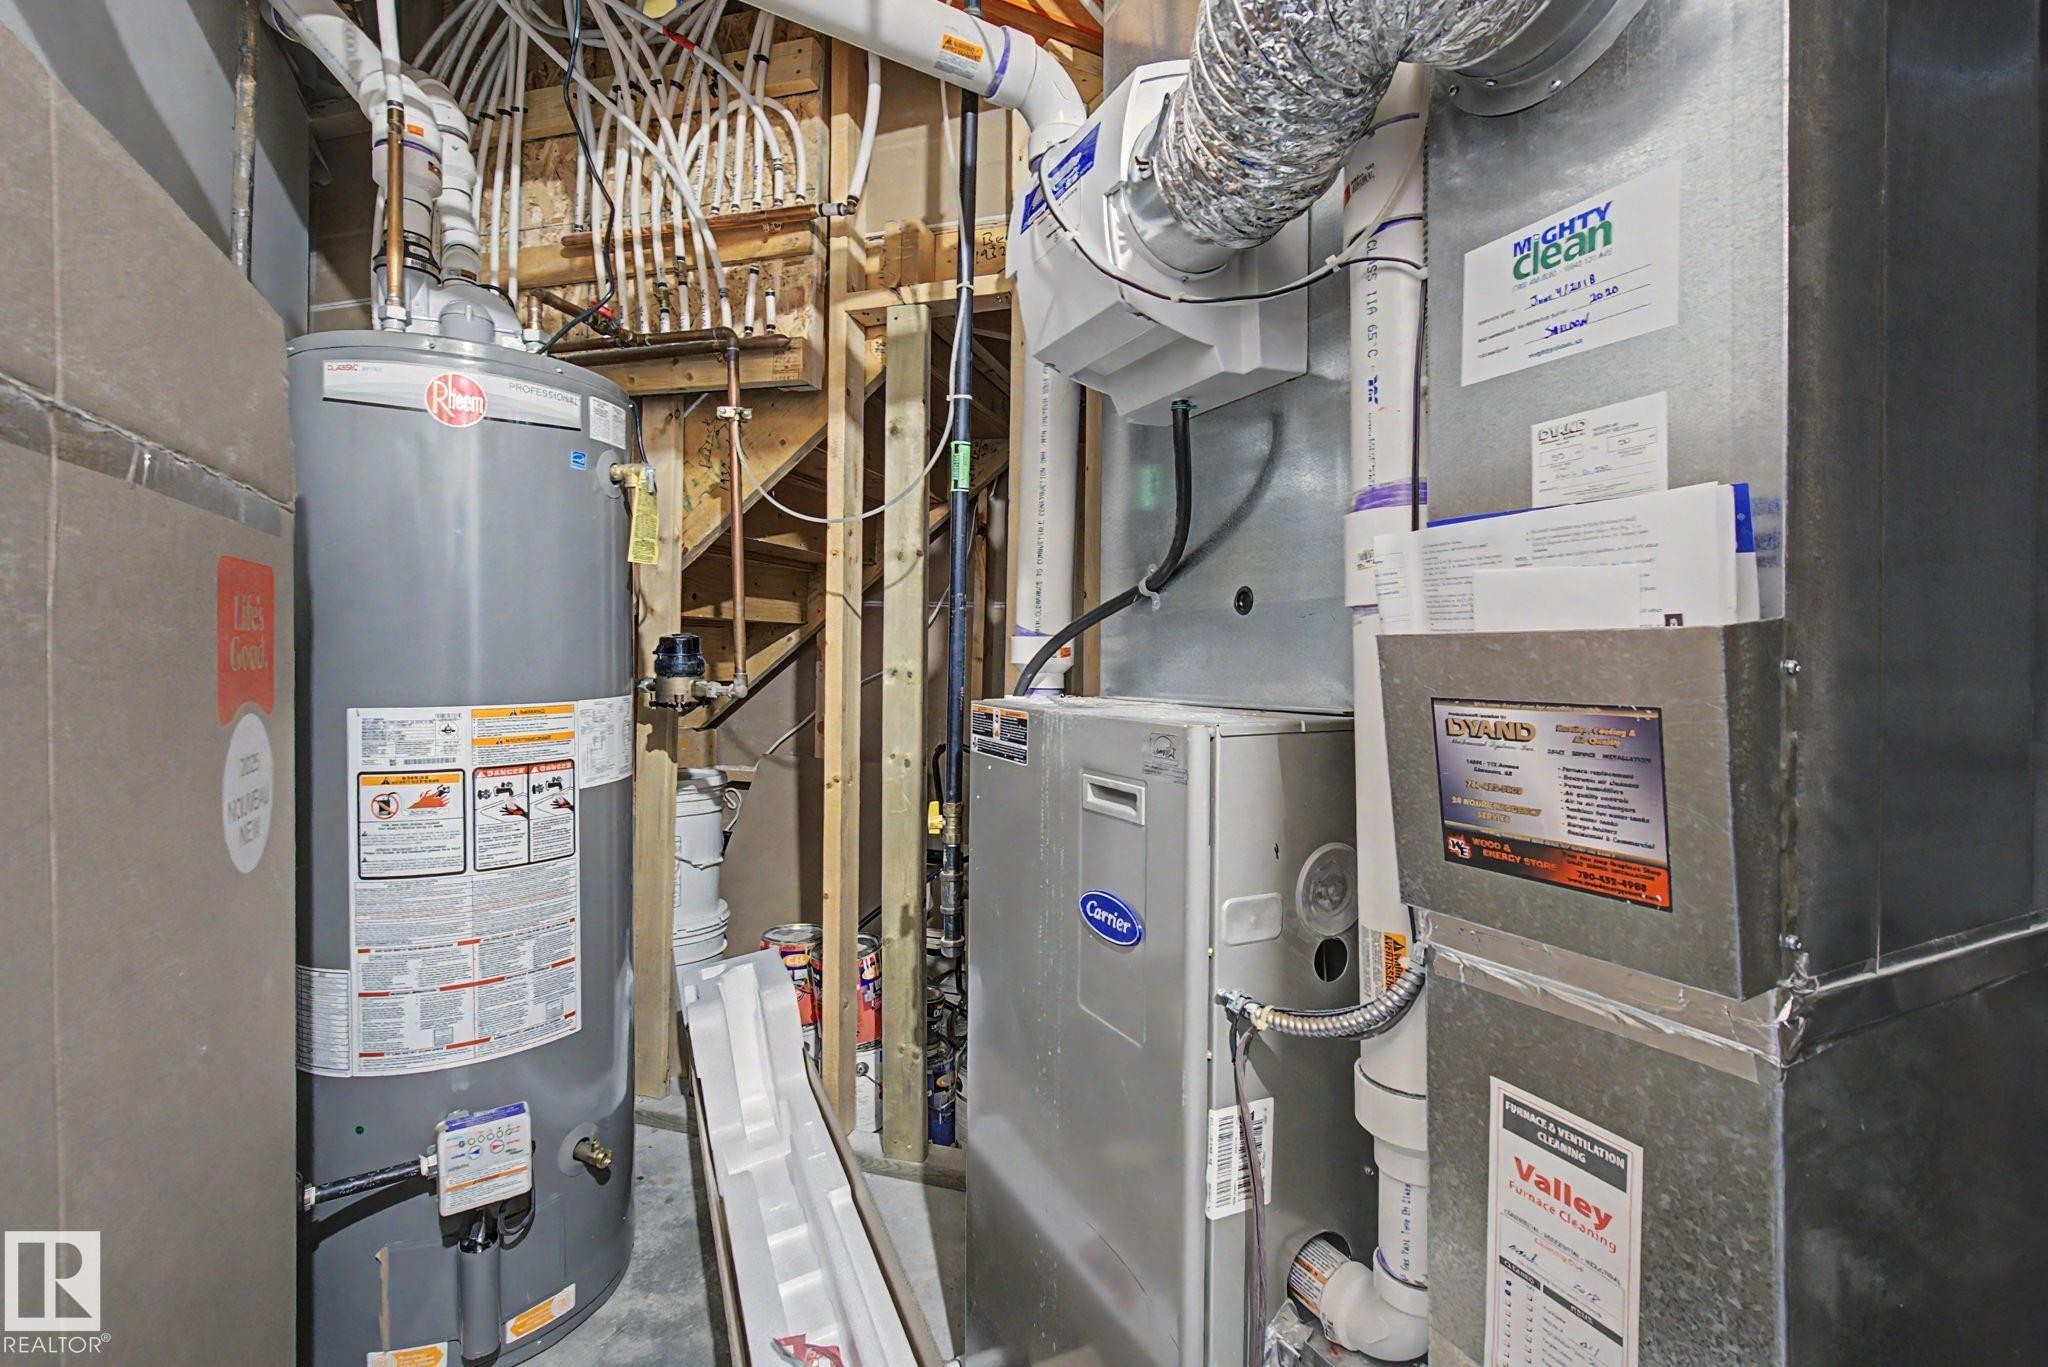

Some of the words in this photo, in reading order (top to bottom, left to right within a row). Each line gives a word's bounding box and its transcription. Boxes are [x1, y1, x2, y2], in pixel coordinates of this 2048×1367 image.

[1513, 220, 1612, 280] clean
[431, 377, 484, 417] Rheem
[509, 381, 579, 408] PROFESSIONAL
[233, 595, 265, 631] Life's
[229, 637, 269, 672] Good.
[1445, 718, 1537, 743] DYAND
[1472, 837, 1501, 850] WOOD
[1482, 848, 1521, 863] ENERGY
[1523, 857, 1558, 871] STORE
[1086, 900, 1131, 934] Carrier
[1384, 934, 1394, 991] AVERTISSEM
[1504, 1100, 1547, 1129] FURNACE
[1548, 1122, 1556, 1134] &
[1557, 1127, 1625, 1170] VENTILATION
[1537, 1131, 1587, 1164] CLEANING
[1514, 1155, 1613, 1230] Valley
[1509, 1180, 1556, 1215] Furnace
[1559, 1210, 1617, 1254] Cleaning
